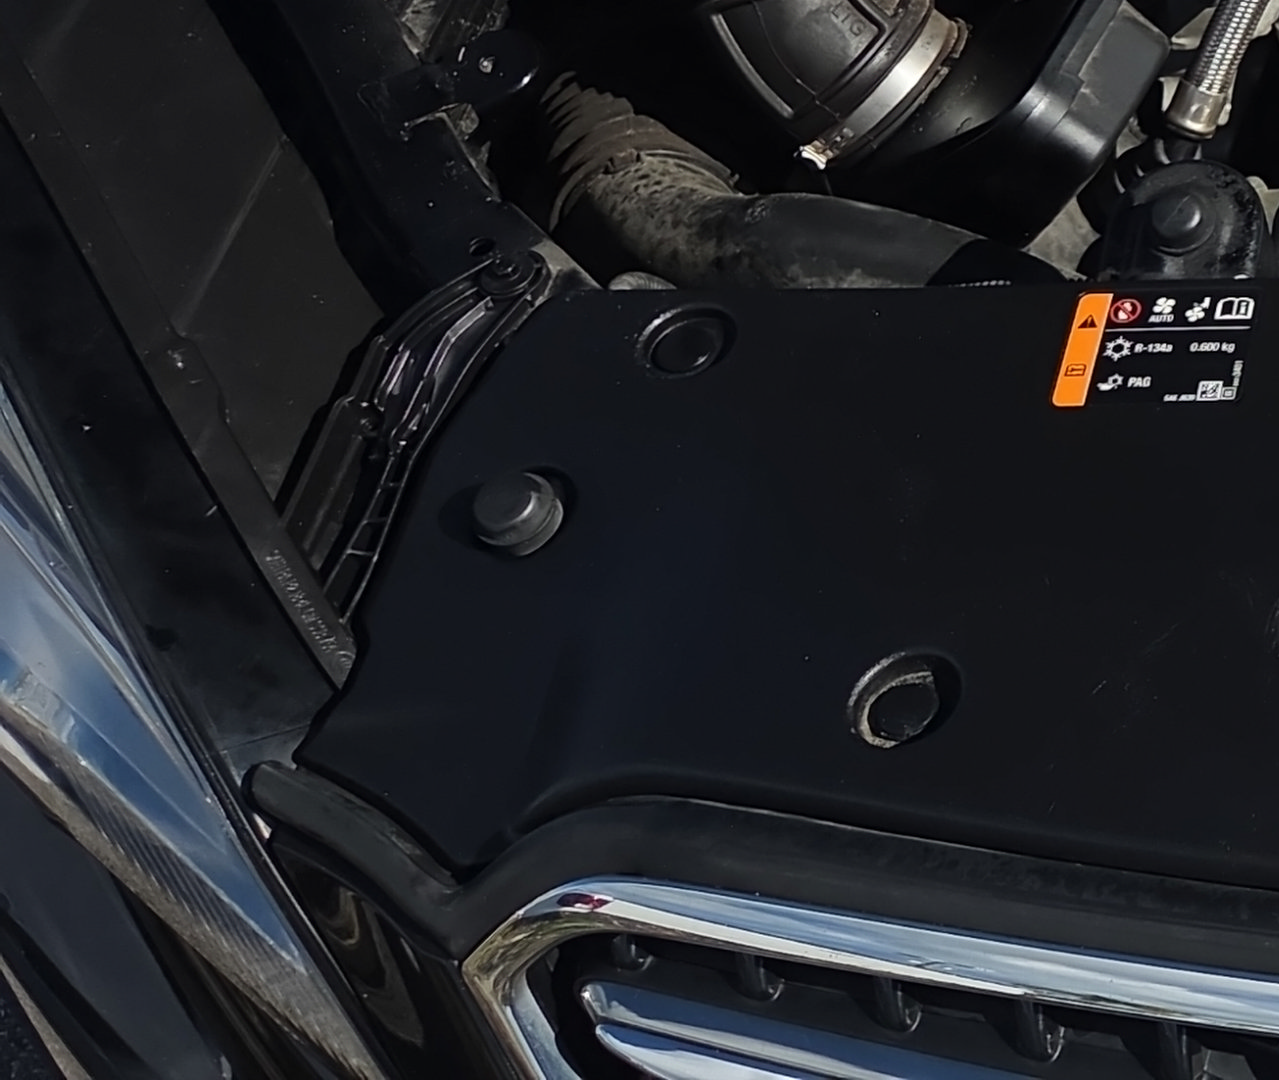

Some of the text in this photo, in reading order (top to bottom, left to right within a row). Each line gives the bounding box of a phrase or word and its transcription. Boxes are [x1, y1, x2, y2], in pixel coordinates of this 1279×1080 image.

[1148, 313, 1174, 323] AUTO
[1134, 341, 1236, 354] R-134a 0.600 kg
[1127, 376, 1152, 388] PAG
